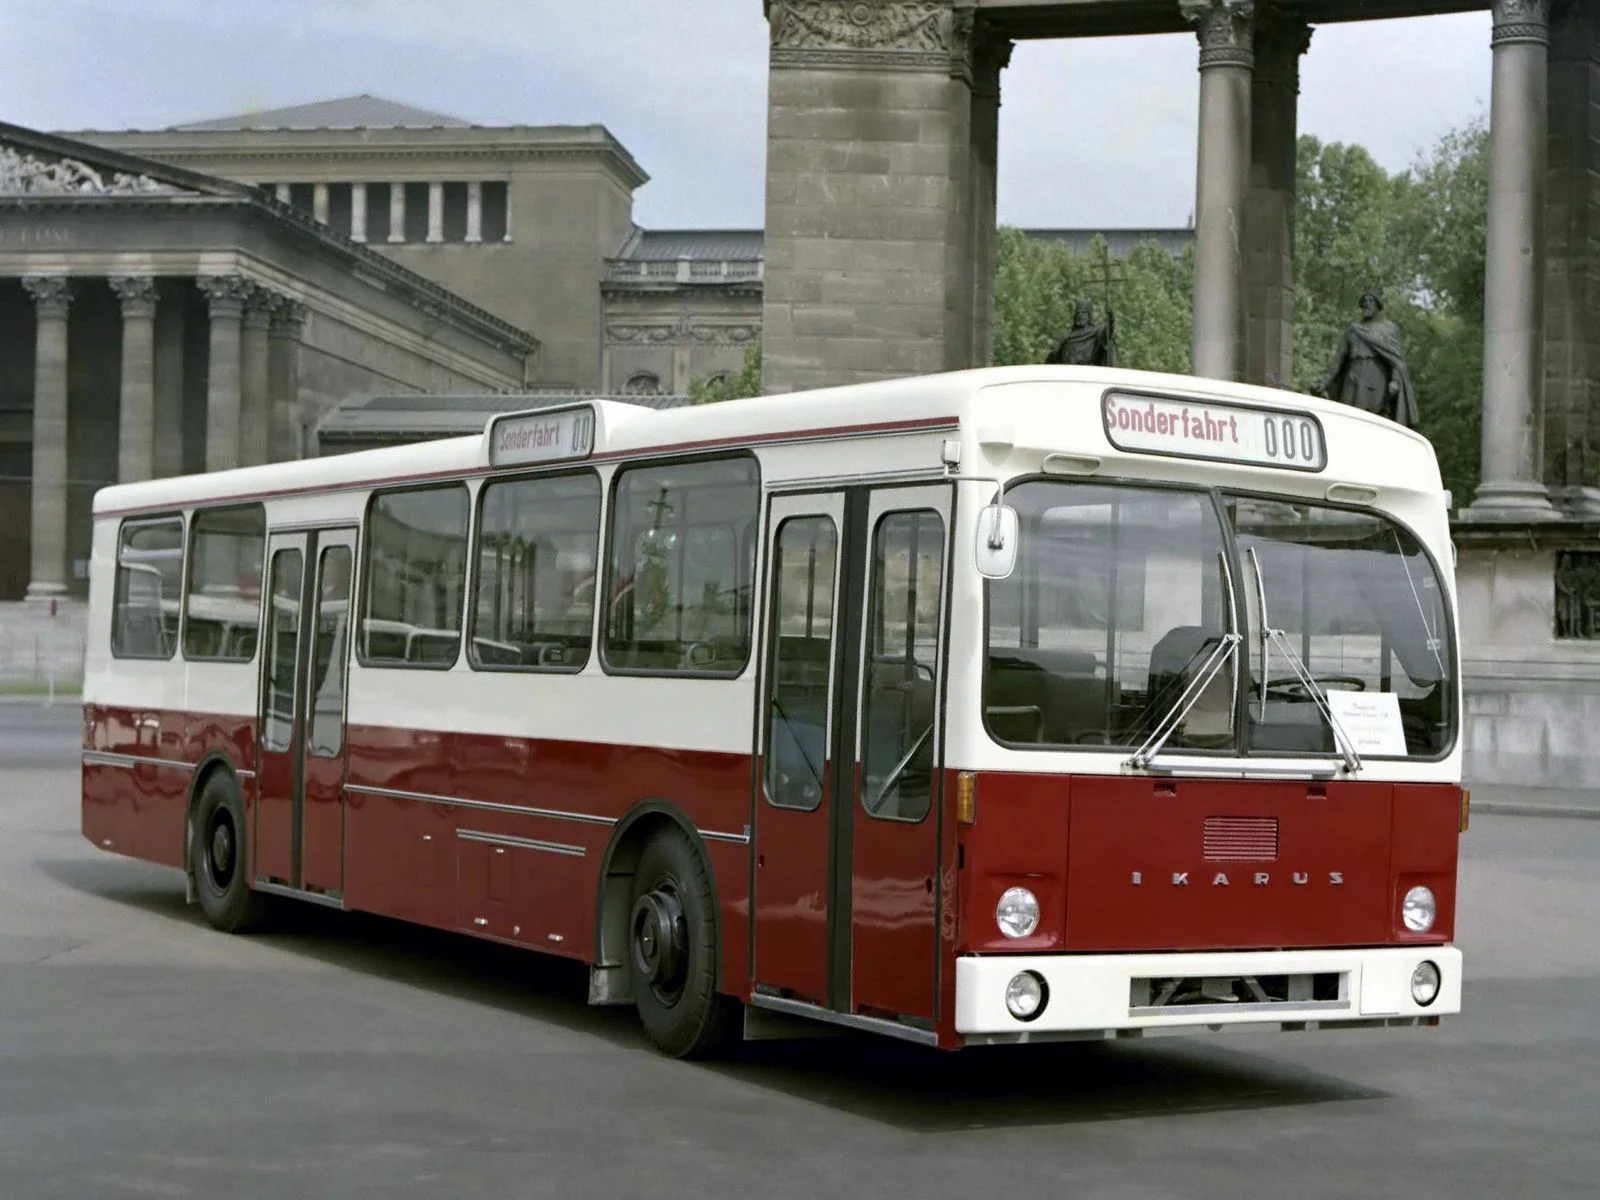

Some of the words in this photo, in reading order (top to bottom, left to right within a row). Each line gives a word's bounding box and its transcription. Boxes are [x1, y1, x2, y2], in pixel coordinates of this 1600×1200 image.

[500, 422, 560, 452] Sonderfahrt
[1107, 398, 1238, 443] Sonderfahrt
[1264, 416, 1314, 461] 000
[1131, 871, 1344, 886] IKARUS
